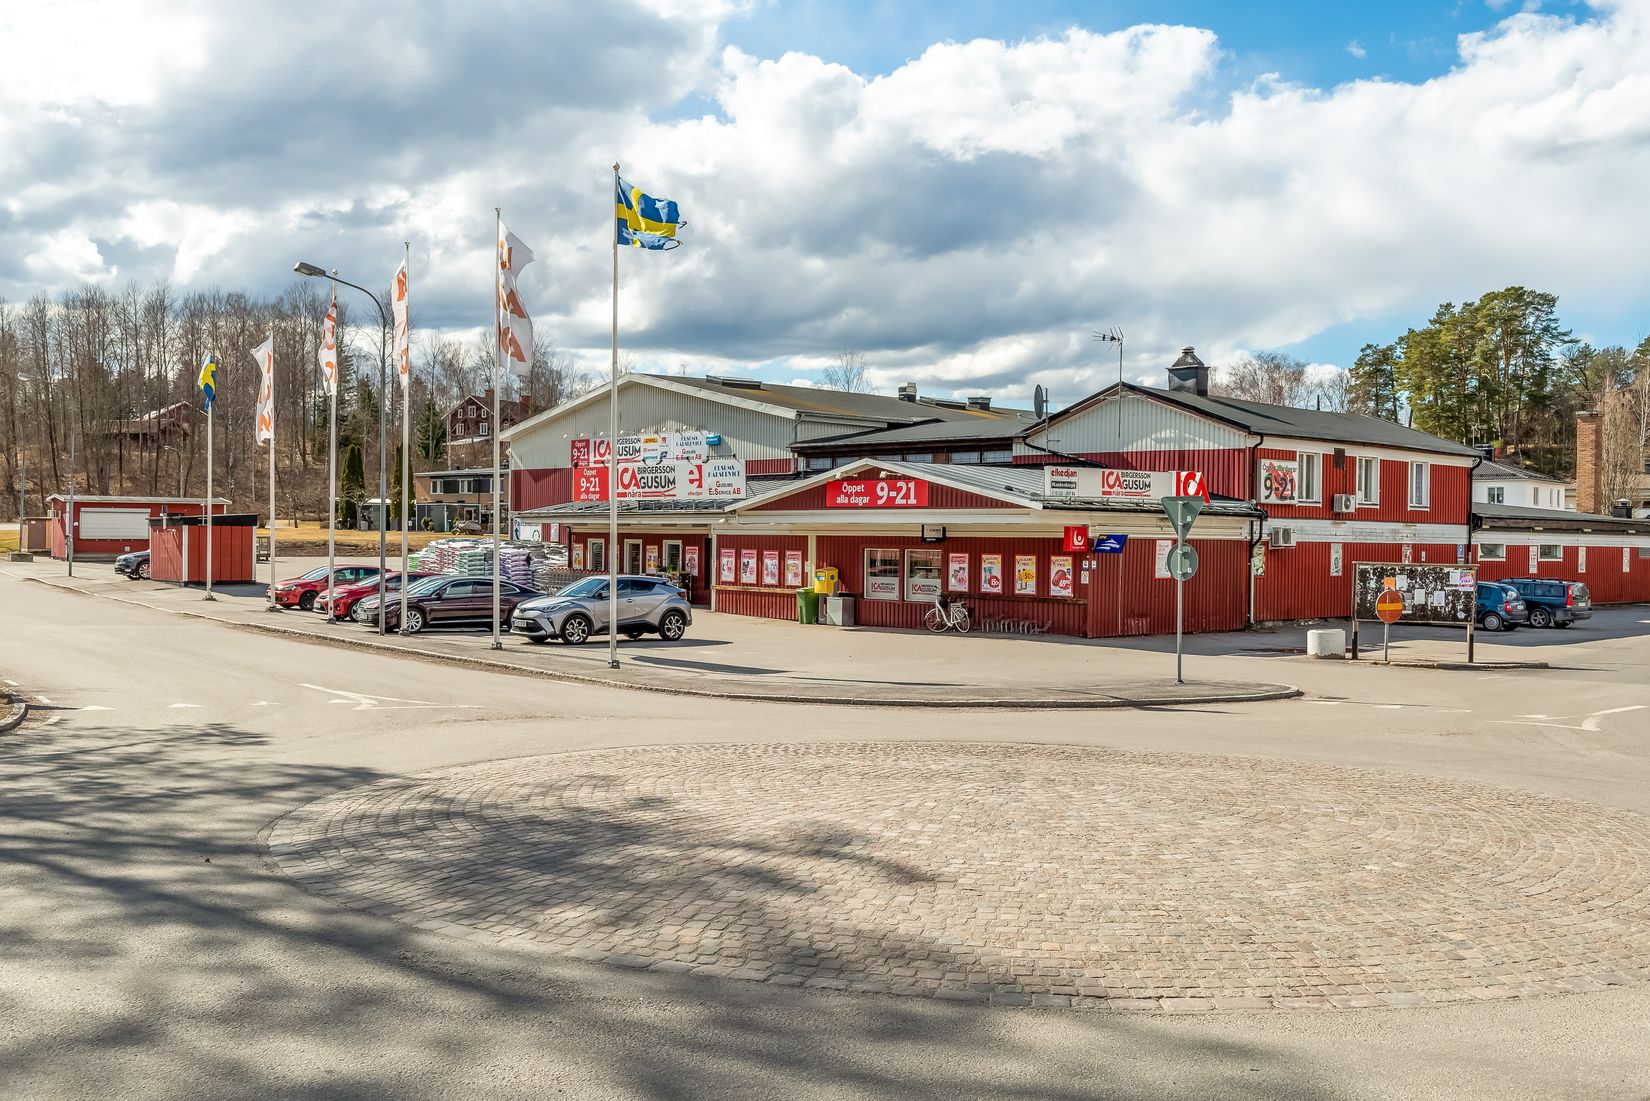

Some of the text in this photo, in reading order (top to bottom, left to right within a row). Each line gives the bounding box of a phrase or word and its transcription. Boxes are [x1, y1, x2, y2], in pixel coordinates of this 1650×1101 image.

[573, 448, 588, 459] 9-21
[617, 446, 641, 456] USUM
[583, 469, 597, 477] Öppet
[637, 466, 676, 475] BIRGERSSON
[580, 478, 600, 491] 9-21
[639, 476, 676, 489] GUSUM
[1101, 471, 1123, 490] ICA
[1122, 479, 1151, 490] GUSUM
[842, 482, 864, 494] Öppet
[1176, 471, 1211, 504] ICA
[1264, 473, 1296, 501] 9-21
[876, 481, 917, 505] 9-21
[836, 495, 870, 506] alla dagar
[912, 584, 922, 592] ICA
